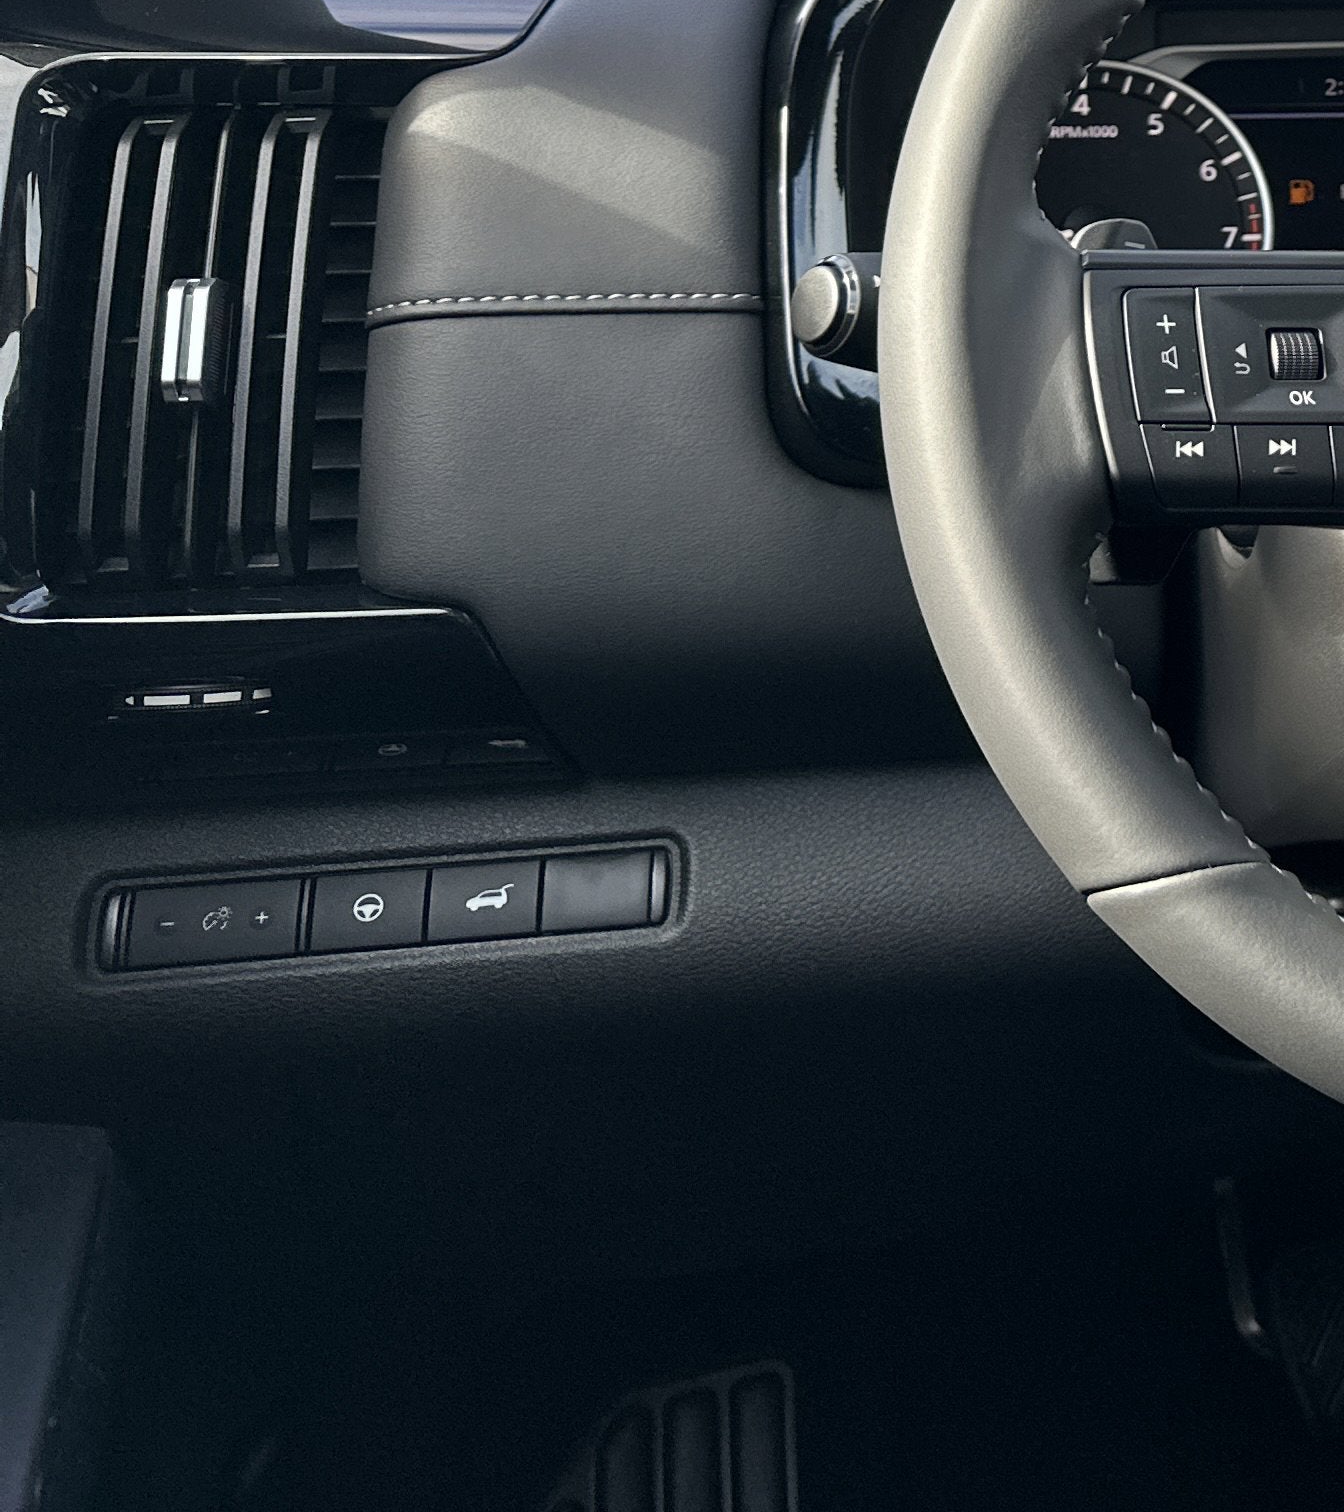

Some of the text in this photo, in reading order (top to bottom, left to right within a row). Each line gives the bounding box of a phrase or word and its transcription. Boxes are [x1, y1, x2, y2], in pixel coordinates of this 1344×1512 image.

[1070, 93, 1091, 116] 4
[1147, 113, 1165, 136] 5
[1199, 159, 1218, 182] 6
[1221, 226, 1239, 248] 7
[1288, 390, 1317, 406] OK
